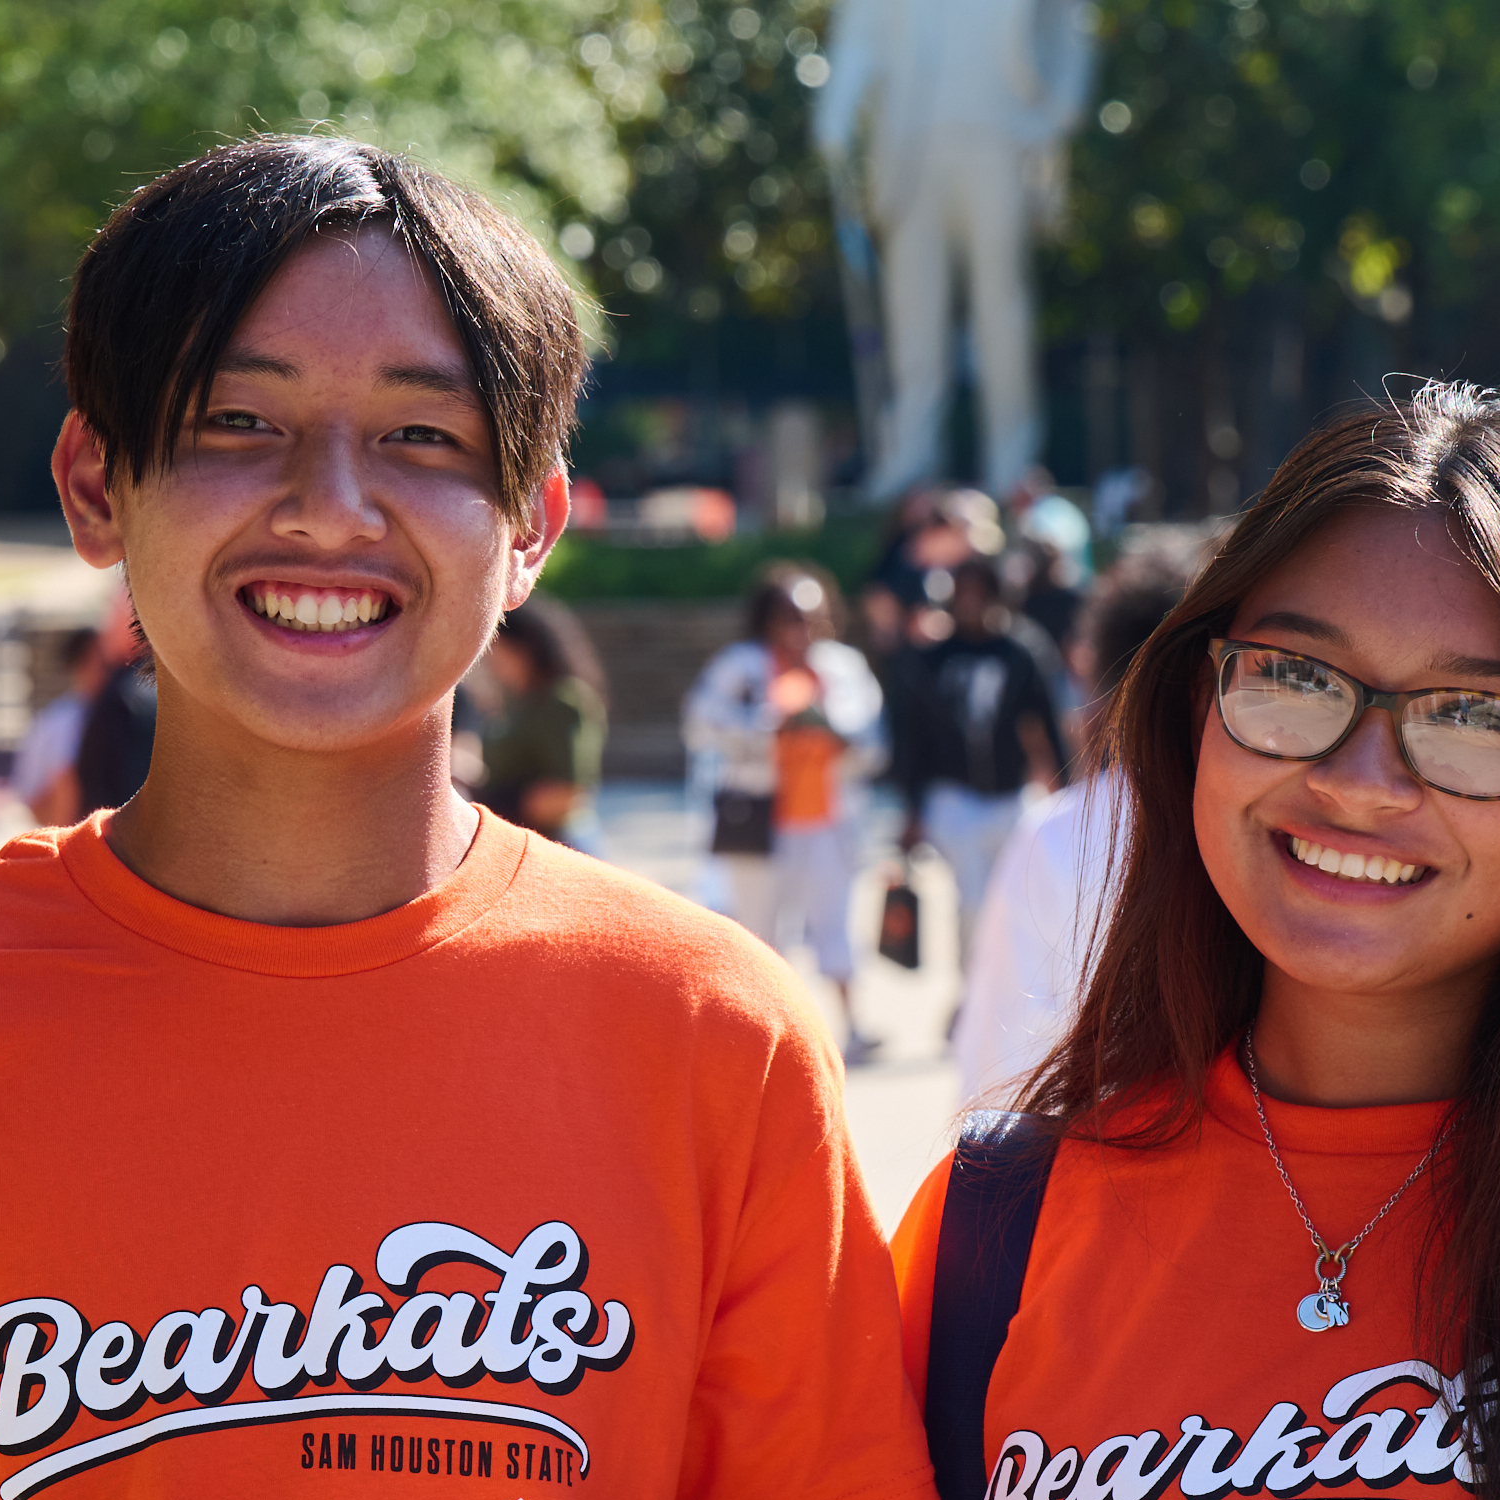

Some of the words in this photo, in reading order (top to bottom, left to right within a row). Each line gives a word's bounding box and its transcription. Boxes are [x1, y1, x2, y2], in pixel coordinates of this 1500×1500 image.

[301, 1432, 357, 1470] SAM
[371, 1434, 493, 1478] HOUSTON
[506, 1442, 573, 1487] STATE
